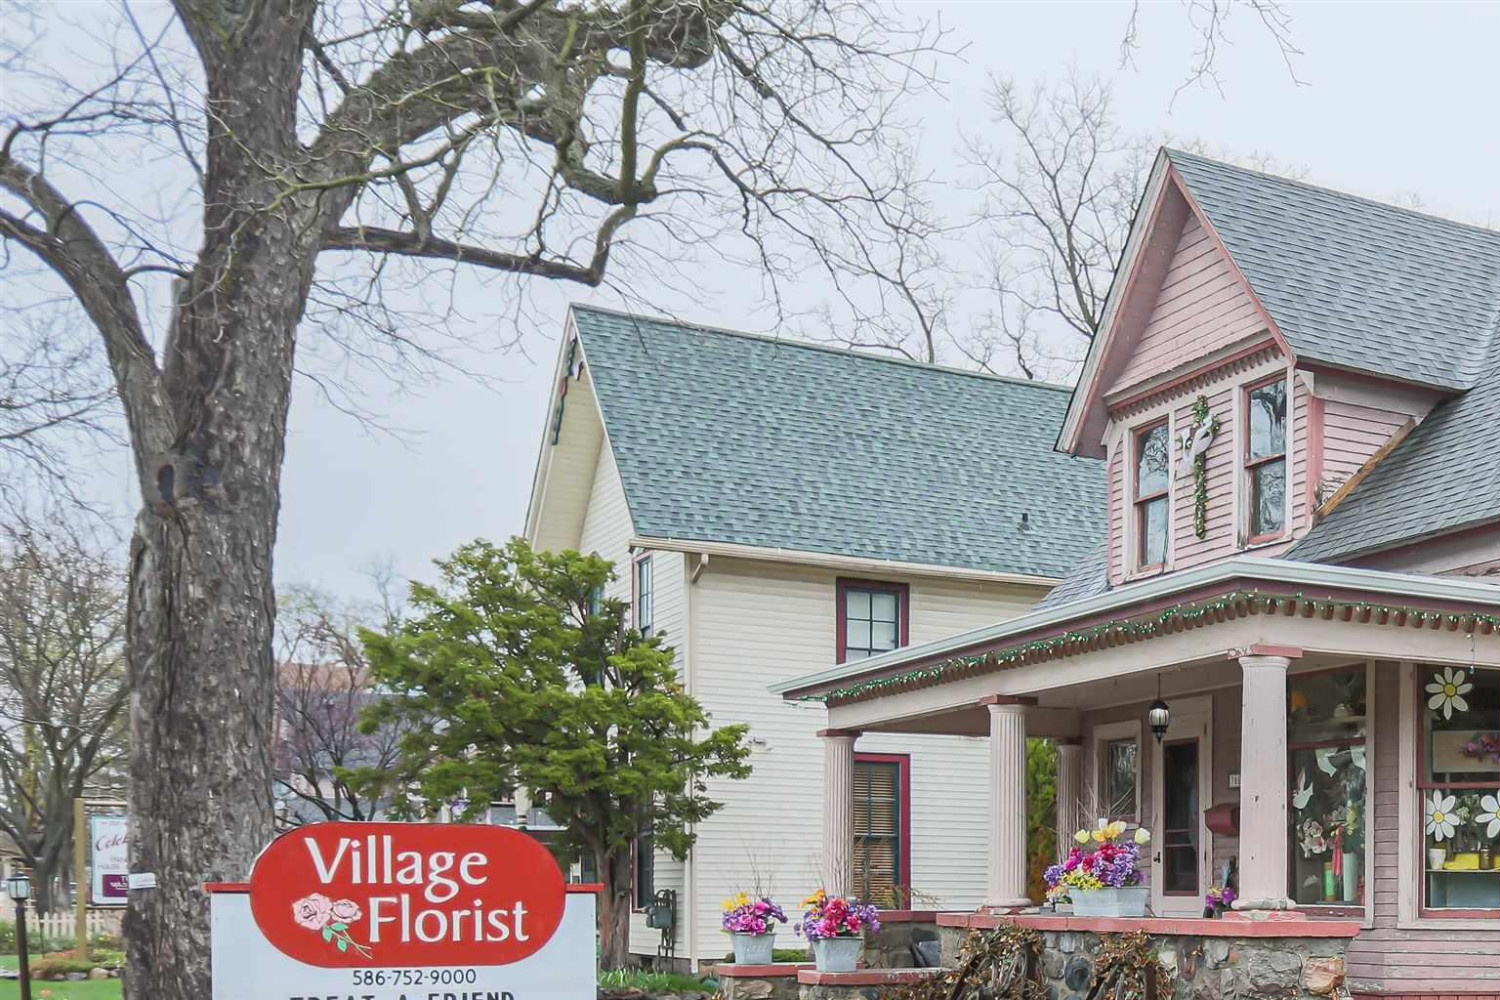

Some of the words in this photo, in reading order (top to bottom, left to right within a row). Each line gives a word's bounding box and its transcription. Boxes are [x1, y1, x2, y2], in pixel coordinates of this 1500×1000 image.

[304, 834, 488, 904] Village
[368, 893, 530, 942] Florist
[352, 968, 477, 986] 586-752-9000
